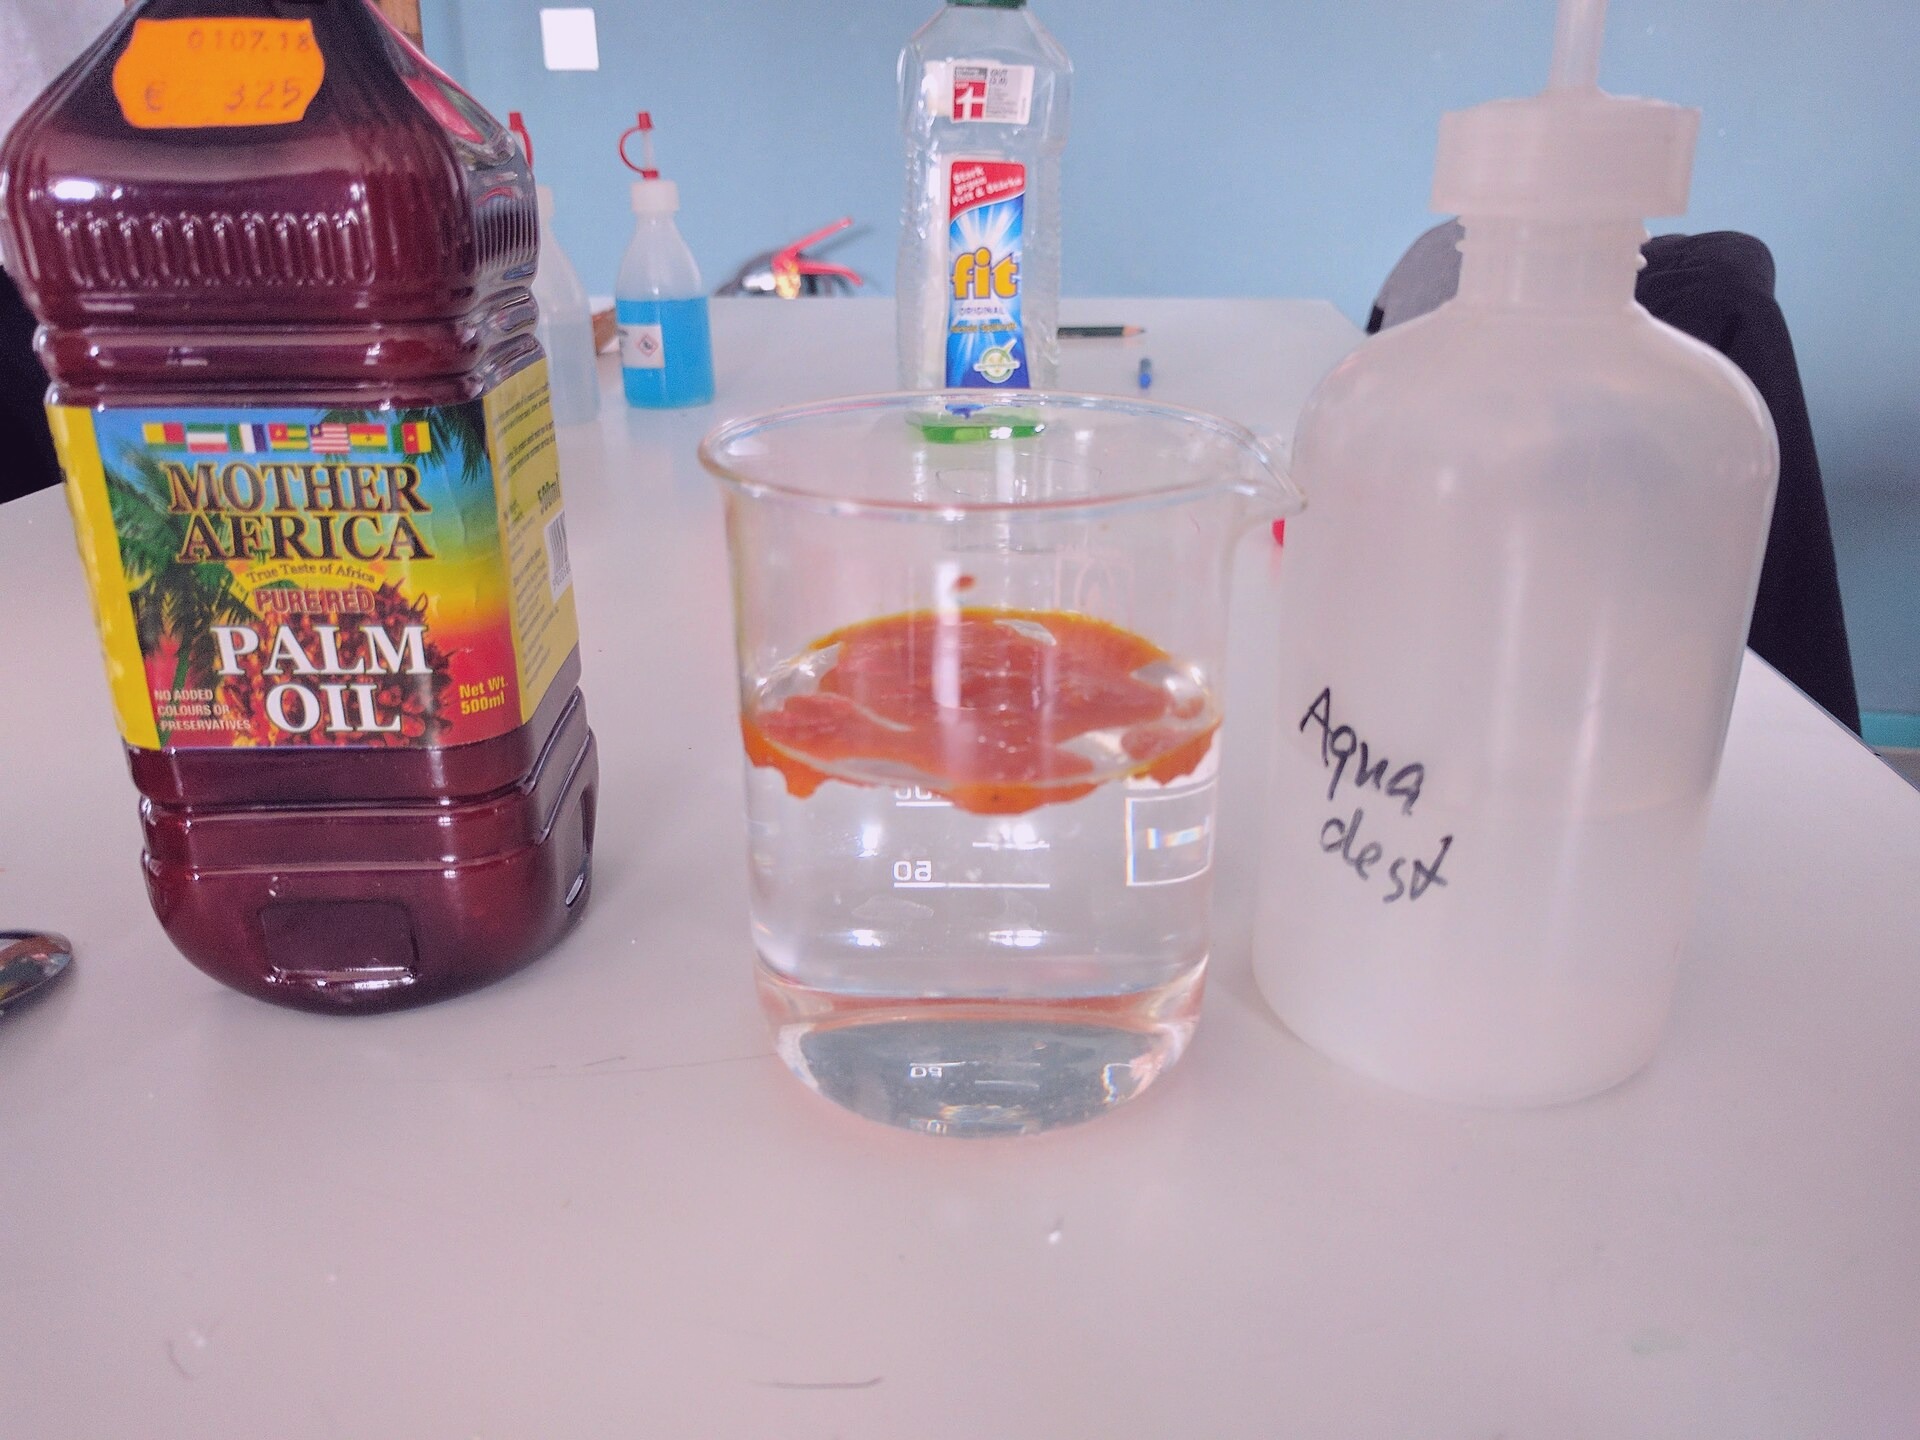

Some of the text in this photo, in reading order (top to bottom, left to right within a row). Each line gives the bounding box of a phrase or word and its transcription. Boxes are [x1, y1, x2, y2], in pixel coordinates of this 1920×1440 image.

[951, 247, 1020, 300] fit
[160, 460, 432, 515] MOTHER
[176, 512, 436, 564] AFRICA
[246, 561, 376, 584] True Taste of Africa
[254, 588, 376, 614] PURE RED
[209, 624, 433, 676] PALM
[154, 688, 214, 702] NO ADDED
[459, 675, 508, 699] Net Wt.
[157, 703, 231, 716] COLOURS OR
[265, 683, 401, 733] OIL
[461, 690, 505, 715] 500ml
[161, 718, 252, 732] PRESERVATIVES
[1299, 687, 1425, 816] Aqua
